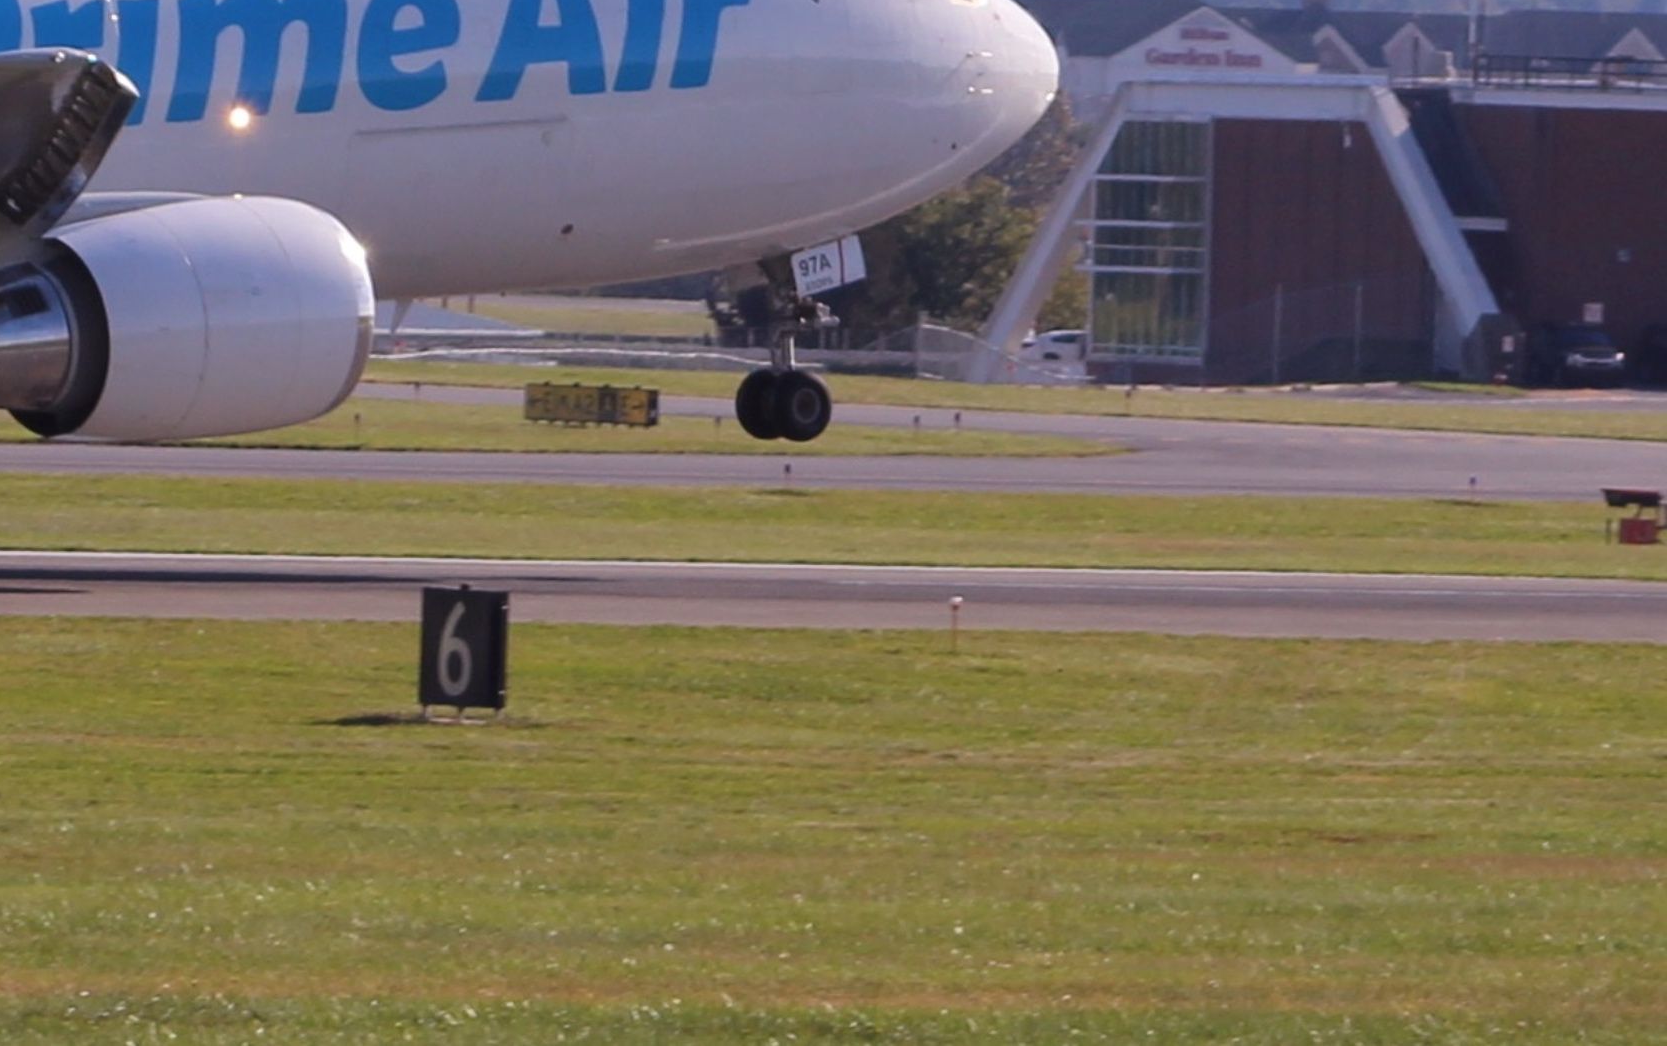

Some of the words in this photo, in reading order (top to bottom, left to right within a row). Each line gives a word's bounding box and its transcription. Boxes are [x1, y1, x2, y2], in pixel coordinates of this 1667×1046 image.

[1145, 47, 1221, 66] Garden
[1224, 49, 1263, 68] Inn
[798, 253, 832, 277] 97A
[437, 600, 473, 697] 6
